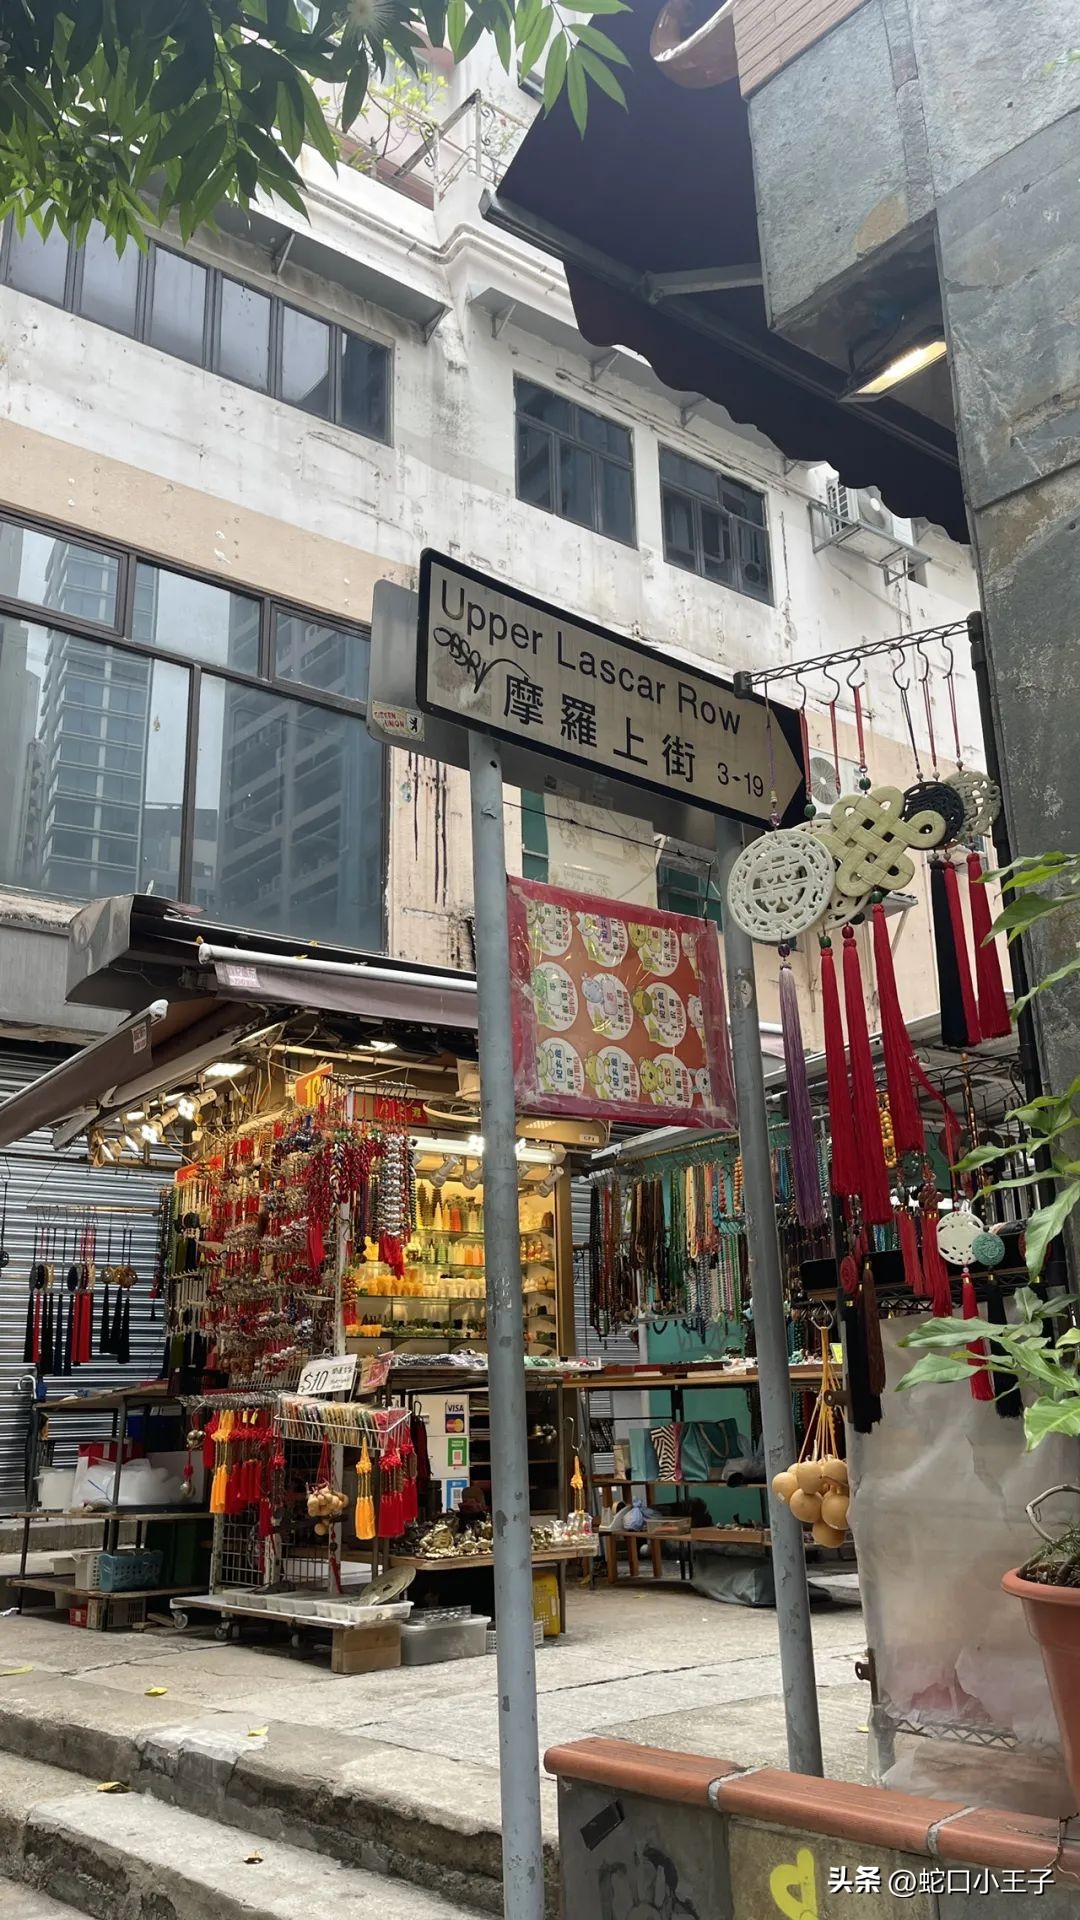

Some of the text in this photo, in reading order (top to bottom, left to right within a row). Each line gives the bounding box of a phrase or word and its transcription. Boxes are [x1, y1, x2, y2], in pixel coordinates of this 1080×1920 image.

[441, 578, 742, 736] Upper Lascar Row
[503, 674, 695, 784] 摩羅上街
[717, 761, 765, 799] 3-19
[303, 1370, 329, 1391] $10
[447, 1404, 464, 1412] VISA
